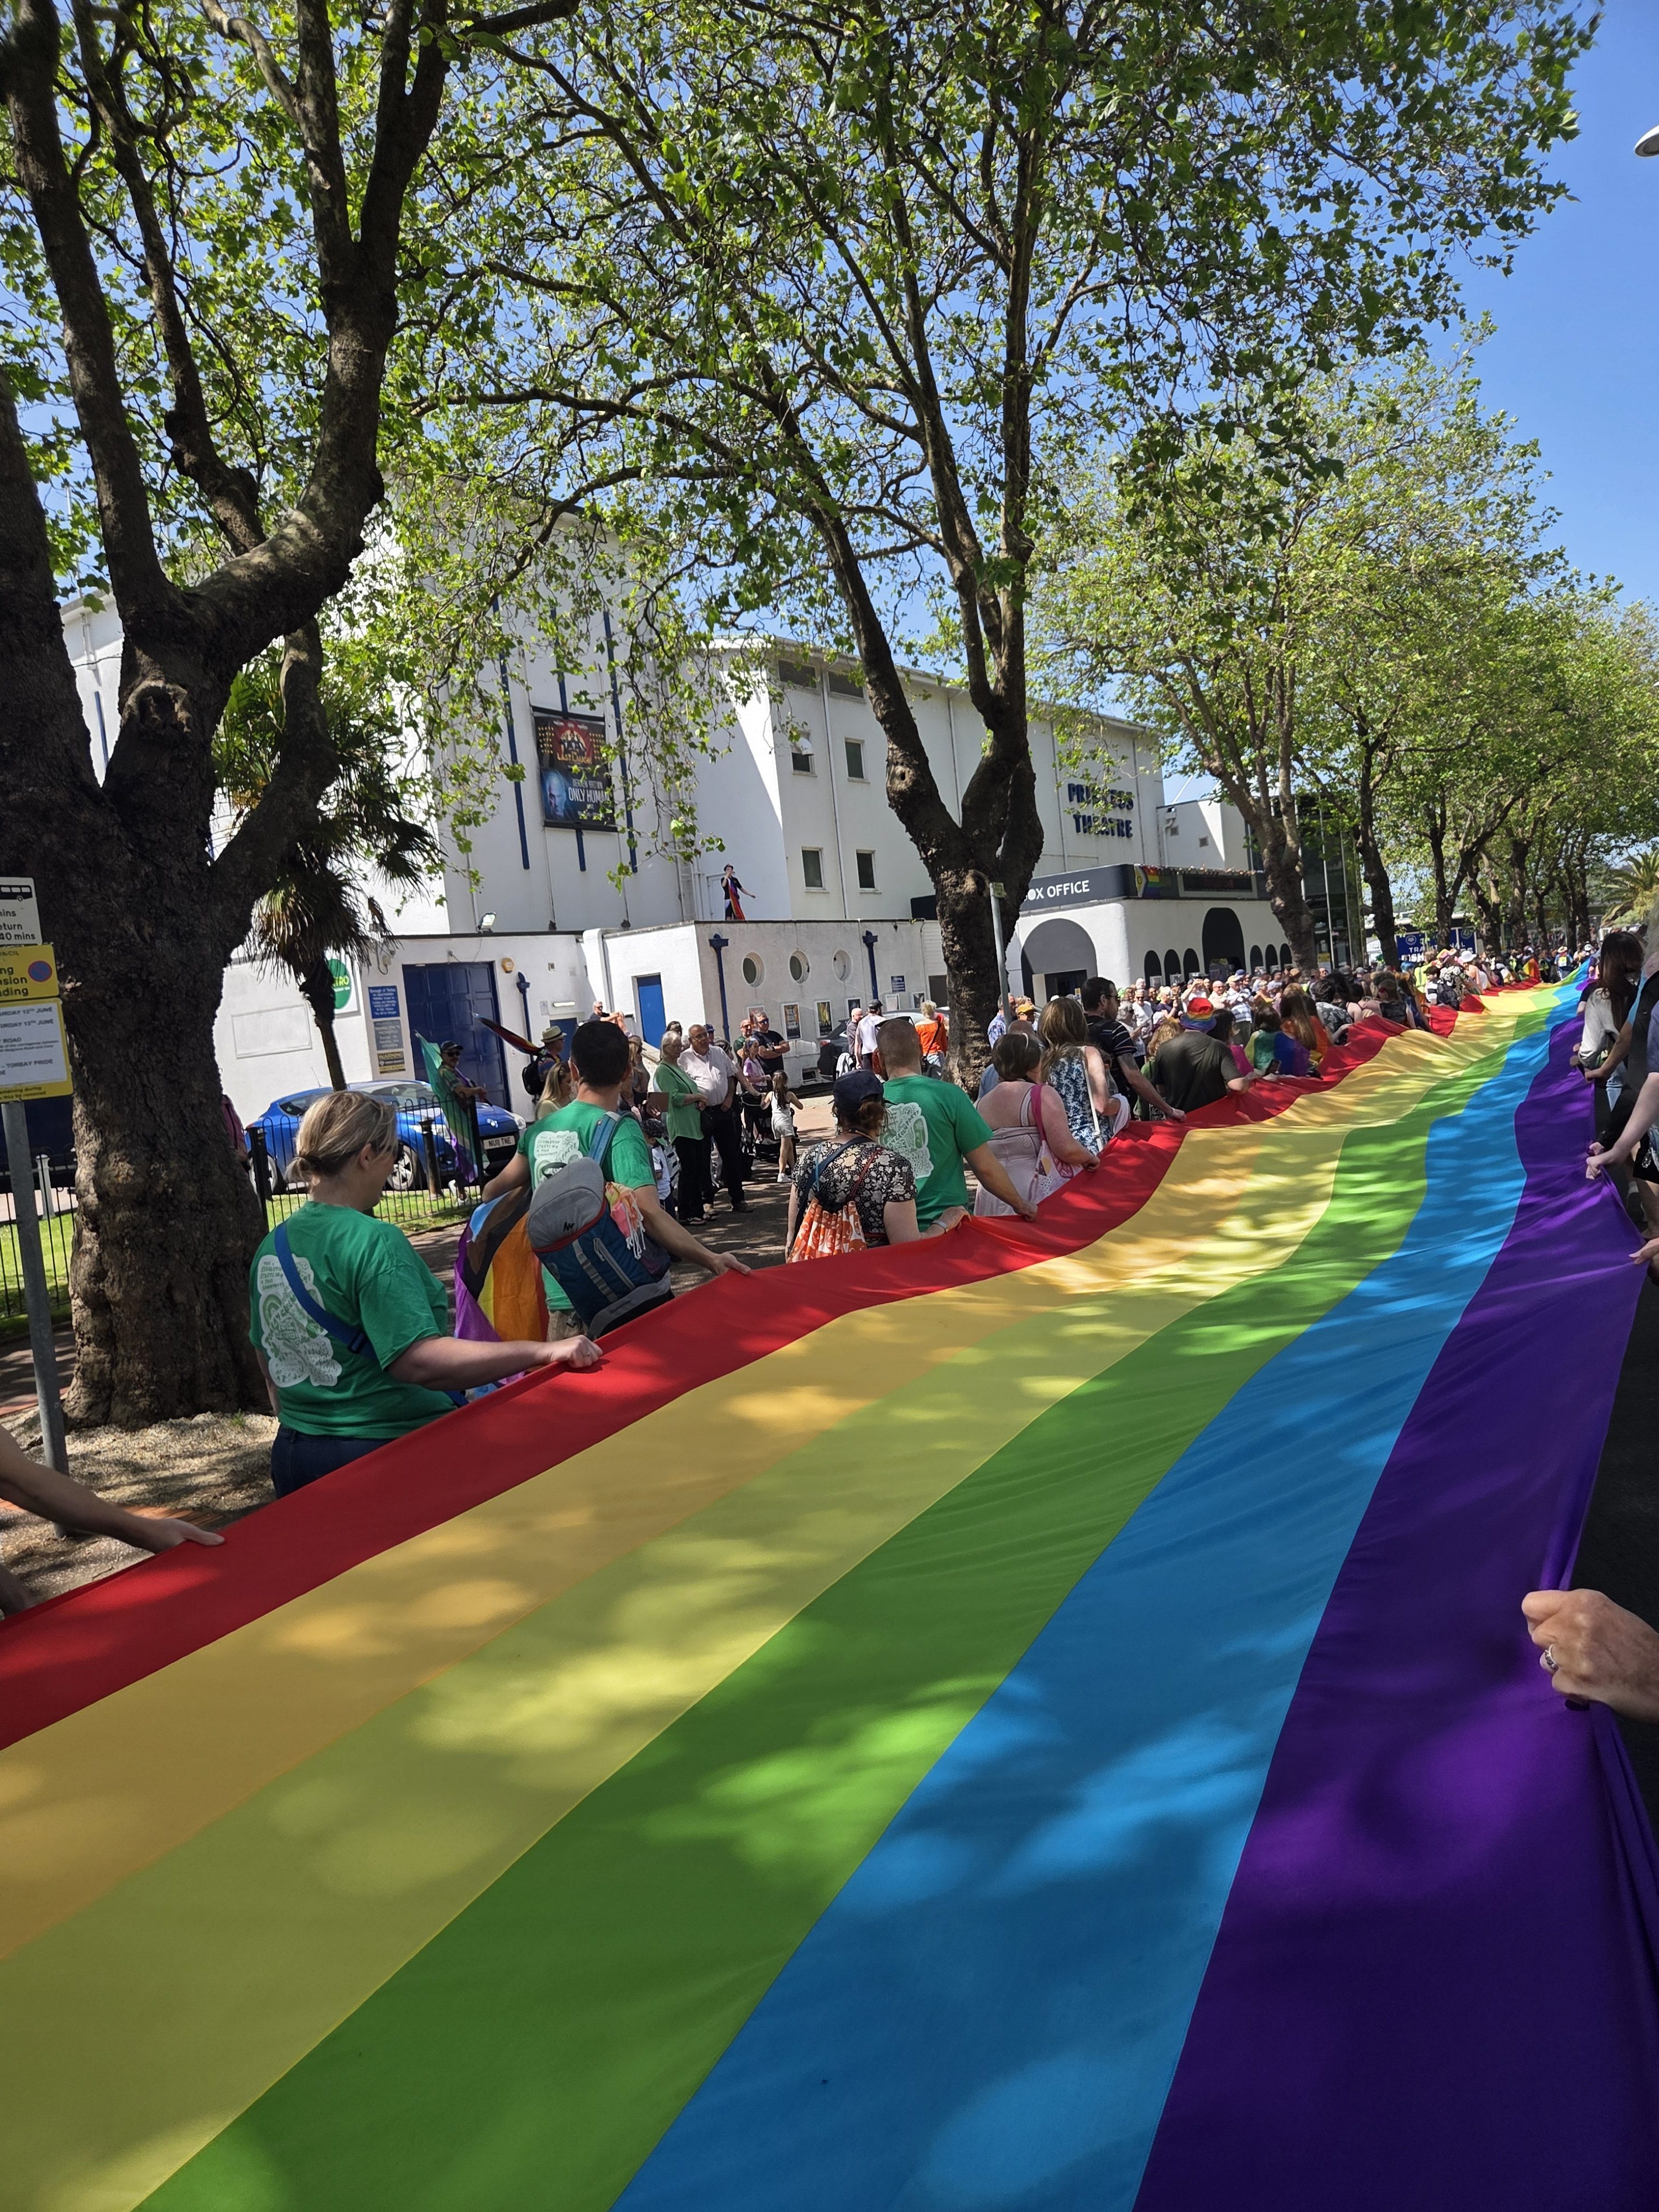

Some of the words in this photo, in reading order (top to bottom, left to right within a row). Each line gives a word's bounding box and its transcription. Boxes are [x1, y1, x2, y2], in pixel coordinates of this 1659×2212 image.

[568, 787, 585, 802] ONLY
[1068, 783, 1134, 810] PRIESS
[1024, 887, 1045, 901] OX
[1047, 880, 1090, 898] OFFICE
[14, 931, 36, 940] mins
[333, 975, 349, 987] TRO
[0, 987, 28, 997] ding
